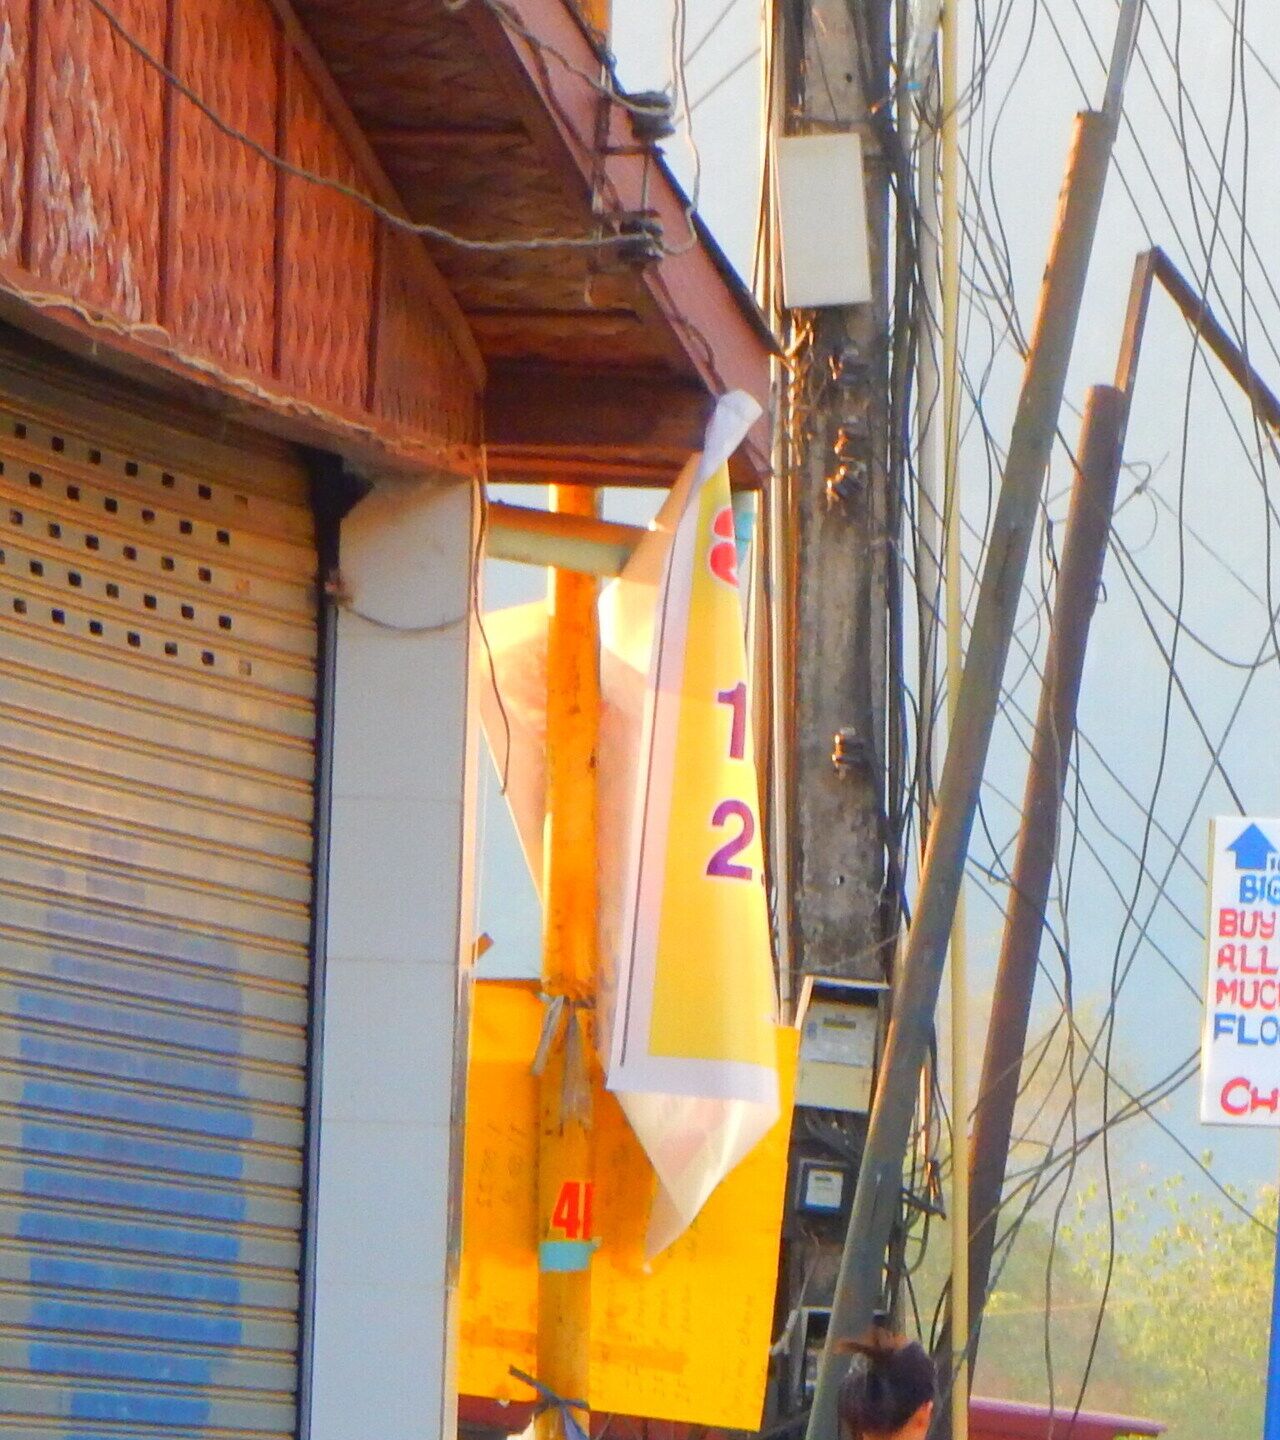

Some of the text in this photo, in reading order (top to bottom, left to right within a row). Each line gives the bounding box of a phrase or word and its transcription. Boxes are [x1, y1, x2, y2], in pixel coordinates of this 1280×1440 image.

[717, 682, 747, 759] 1
[1218, 907, 1277, 939] BUY
[1217, 943, 1279, 974] ALL
